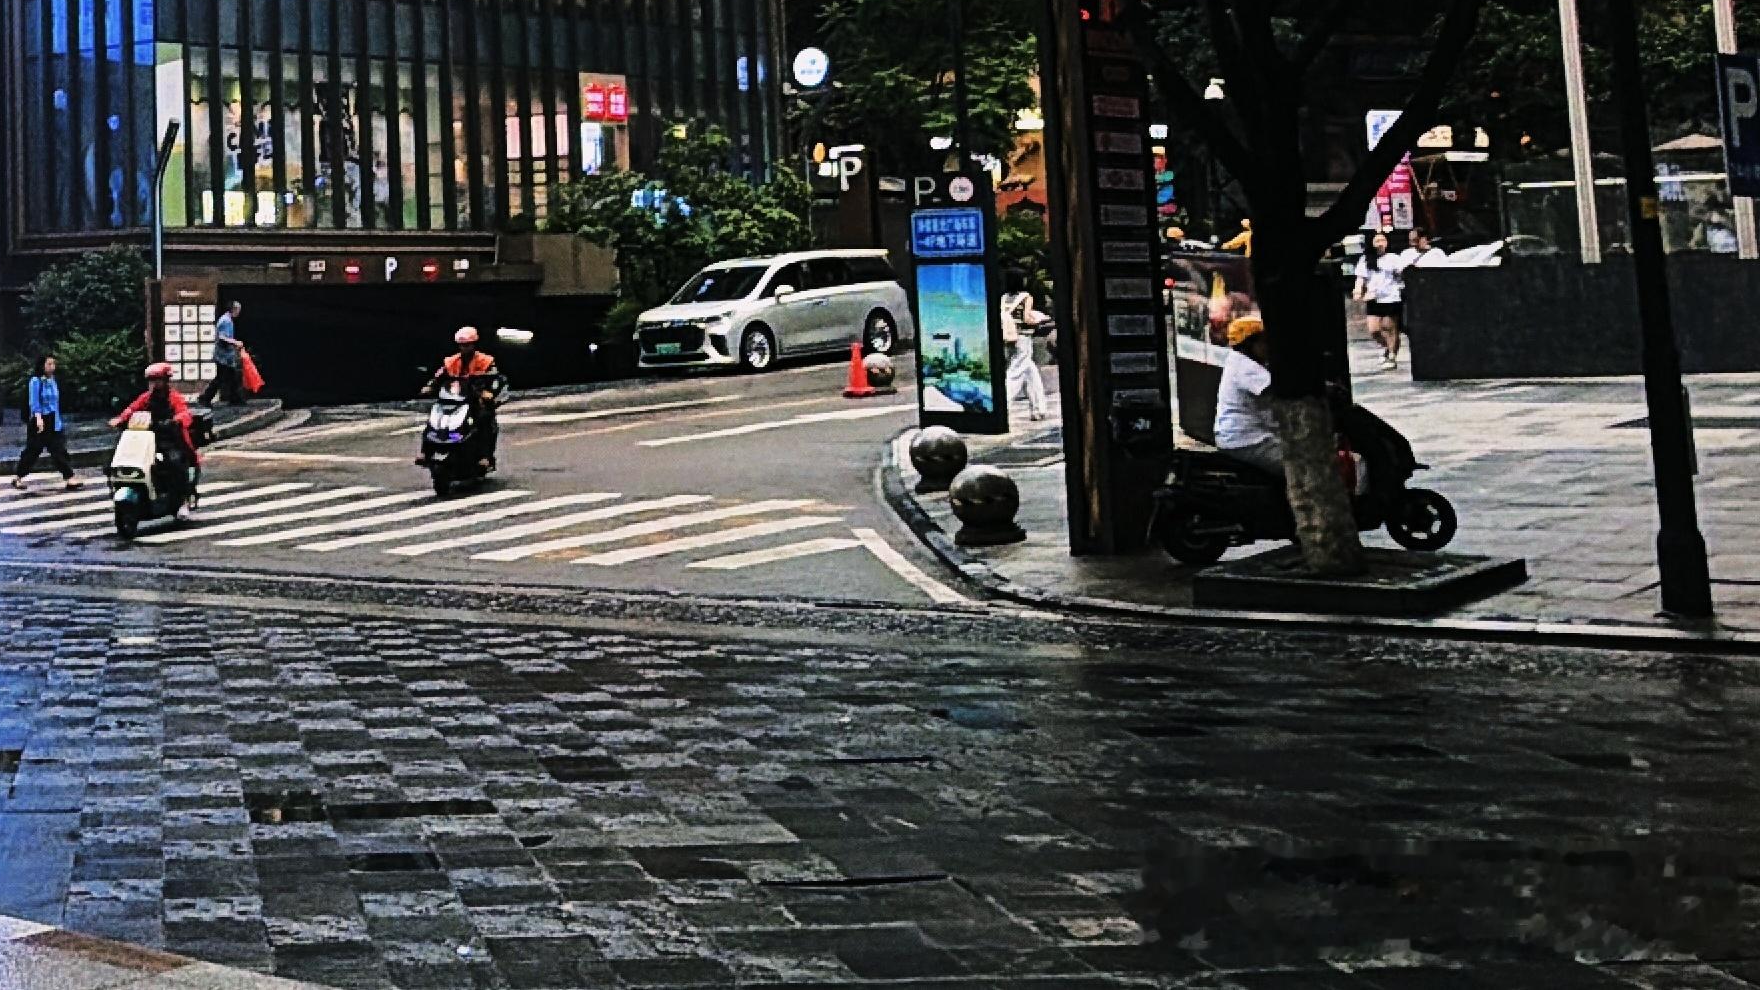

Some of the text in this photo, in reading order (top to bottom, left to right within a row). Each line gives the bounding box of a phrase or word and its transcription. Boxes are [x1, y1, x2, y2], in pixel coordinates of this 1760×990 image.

[1726, 66, 1758, 148] P
[840, 156, 862, 192] P
[914, 176, 937, 206] P
[385, 256, 398, 282] P
